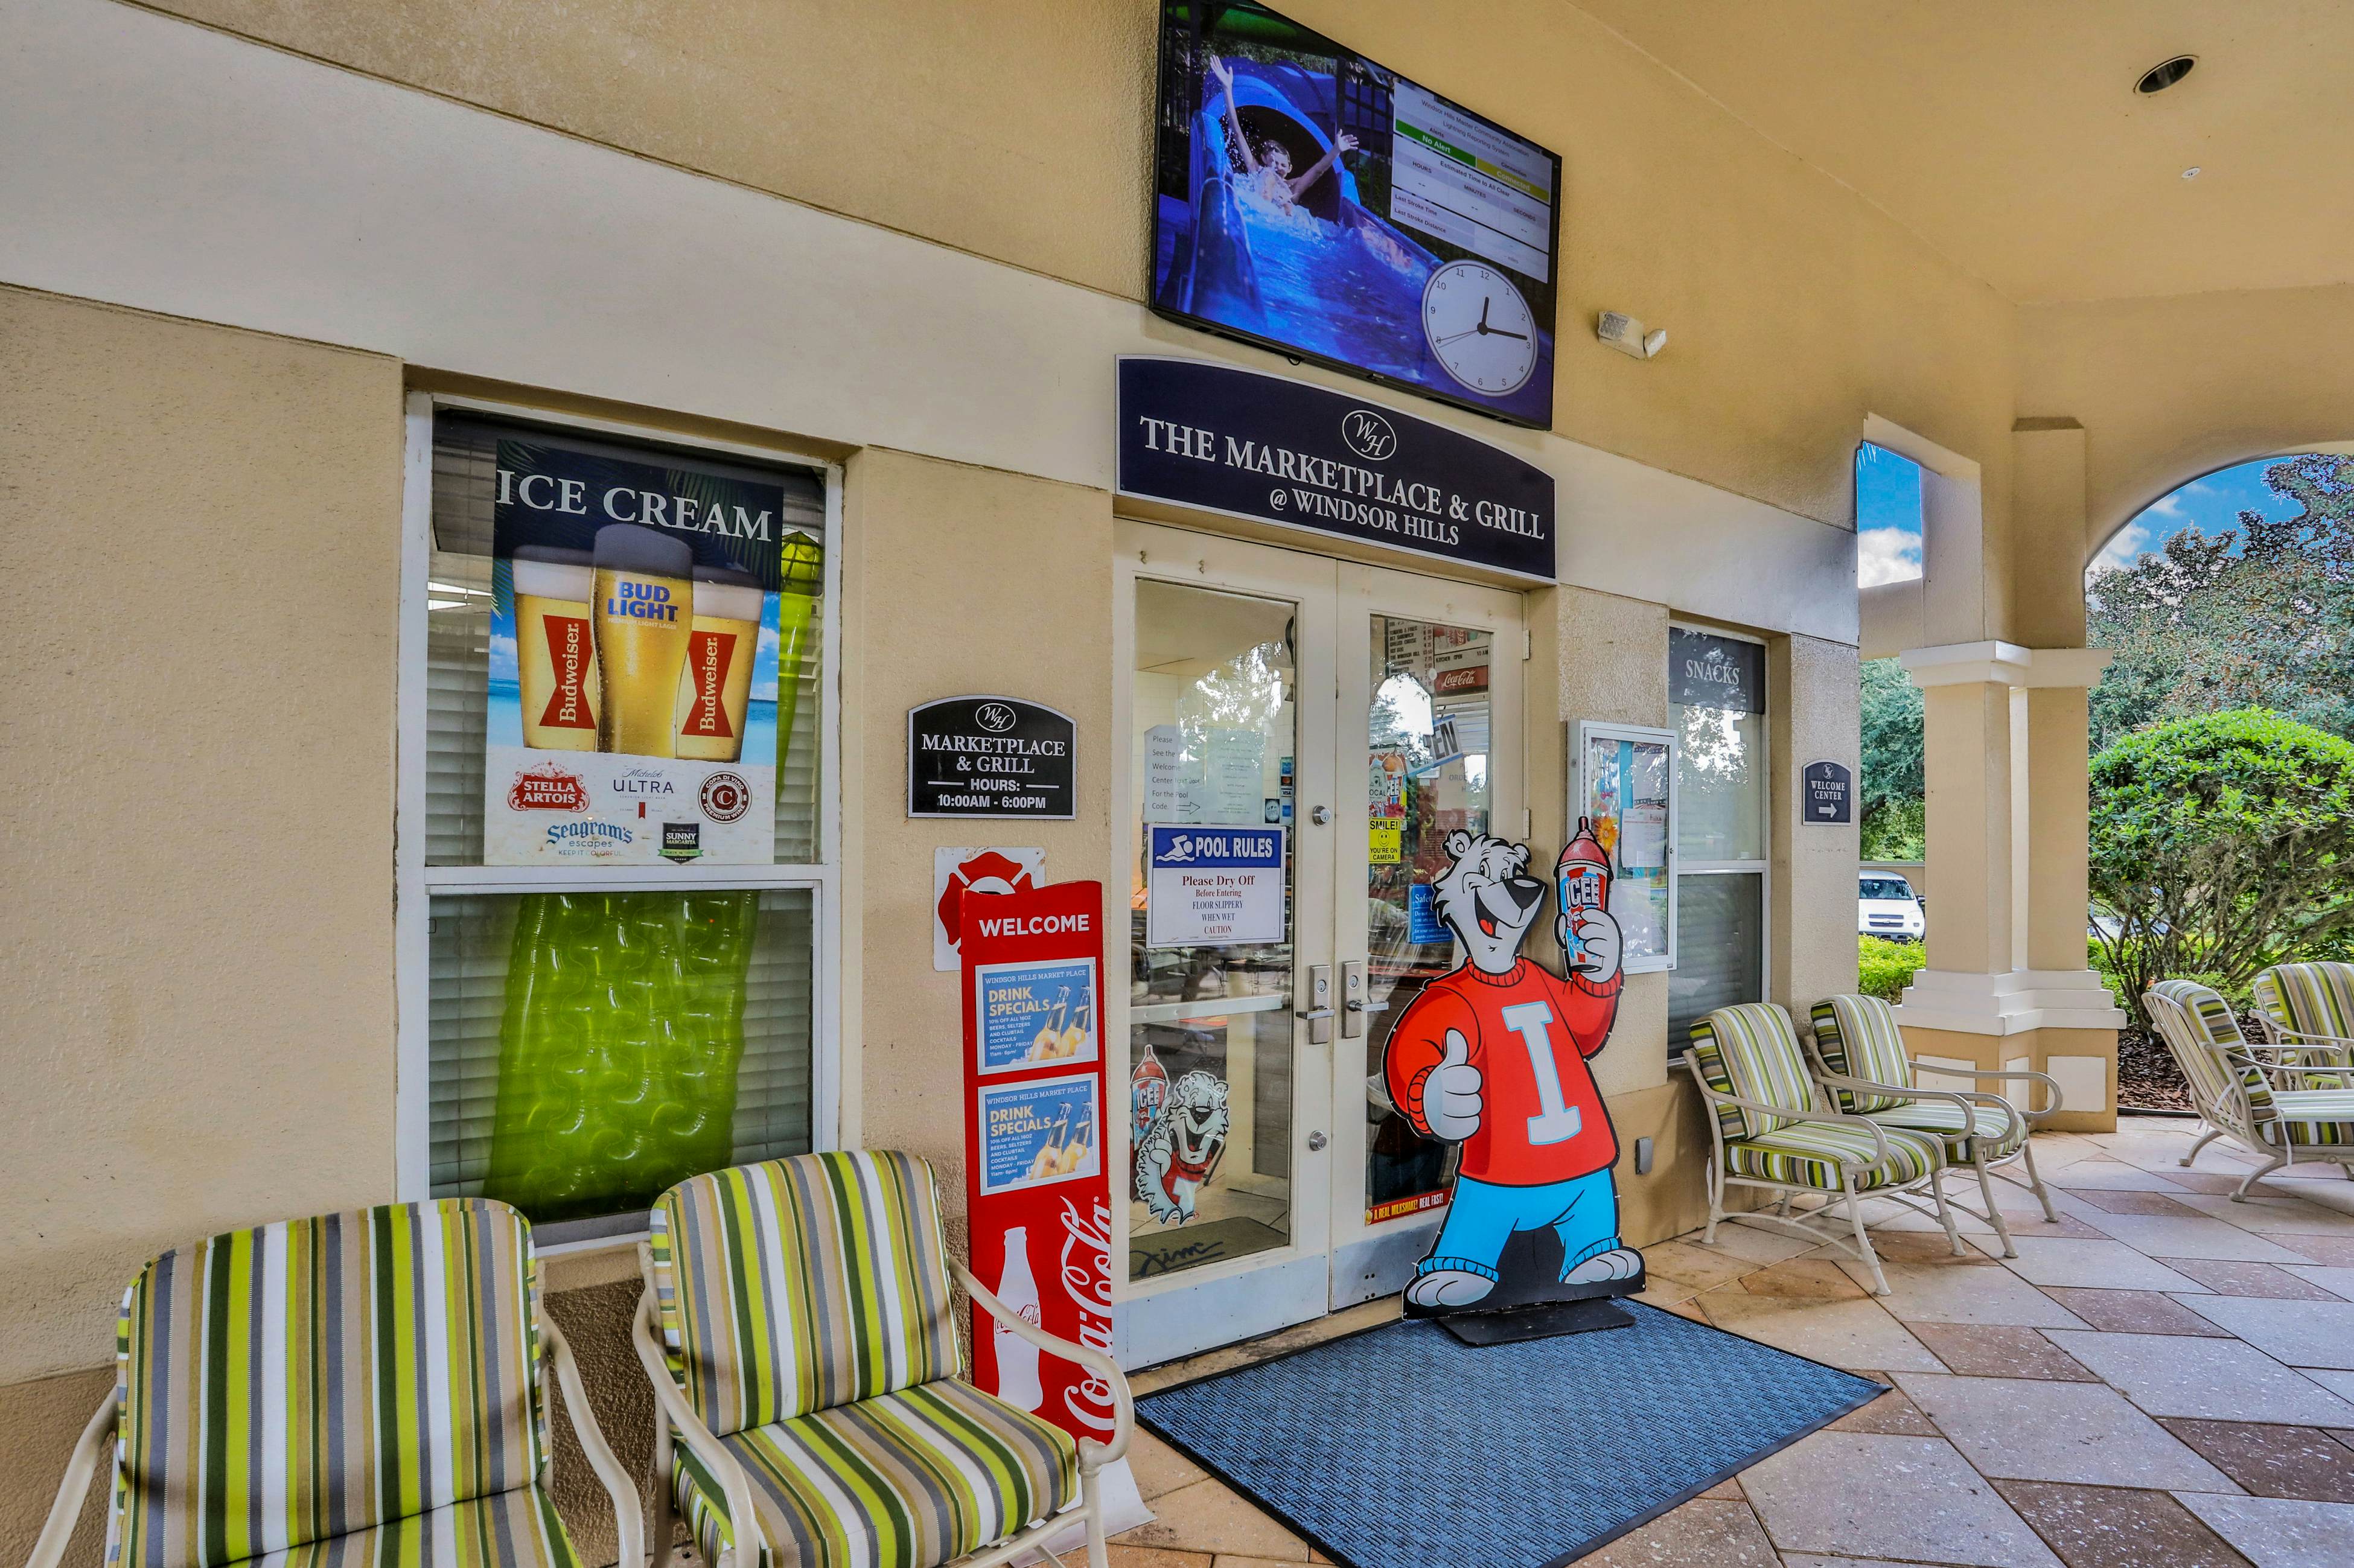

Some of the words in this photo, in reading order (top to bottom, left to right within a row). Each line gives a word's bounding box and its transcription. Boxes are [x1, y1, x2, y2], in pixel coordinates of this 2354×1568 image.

[1421, 99, 1443, 115] Windsor
[1444, 111, 1455, 120] Hills
[1456, 116, 1473, 130] Master
[1474, 124, 1502, 144] Community
[1502, 139, 1529, 157] Association
[1429, 127, 1444, 138] Alerts
[1422, 135, 1432, 145] No
[1434, 139, 1451, 153] Alert
[1443, 121, 1466, 137] Lightning
[1467, 132, 1491, 149] Reporting
[1491, 144, 1510, 157] System
[1412, 161, 1432, 174] HOURS
[1501, 162, 1527, 177] Connection
[1440, 160, 1467, 178] Estimated
[1468, 173, 1481, 183] Time
[1497, 186, 1510, 197] Clear
[1496, 171, 1530, 192] Connected
[1464, 184, 1487, 199] MINUTES
[1395, 194, 1406, 203] Last
[1408, 199, 1424, 210] Stroke
[1425, 206, 1438, 216] Time
[1394, 208, 1406, 218] Last
[1407, 212, 1423, 224] Stroke
[1424, 220, 1447, 234] Distance
[1513, 207, 1536, 221] SECONDS
[1456, 267, 1465, 278] 11
[1480, 270, 1490, 280] 12
[1436, 280, 1446, 290] 10
[1430, 306, 1436, 314] 9
[1478, 377, 1483, 386] 6
[1501, 378, 1507, 386] 5
[1139, 415, 1216, 463] THE
[1224, 435, 1442, 515] MARKETPLACE
[1449, 494, 1469, 521] &
[1475, 500, 1546, 541] GRILL
[496, 469, 587, 515] ICE
[603, 487, 773, 542] CREAM
[1269, 488, 1288, 511] @
[1292, 488, 1399, 534] WINDSOR
[1403, 517, 1459, 546] HILLS
[618, 581, 670, 603] BUD
[607, 598, 678, 622] LIGHT
[559, 622, 579, 723] Budweiser
[1443, 670, 1477, 687] Coca-Cola
[1685, 659, 1741, 686] SNACKS
[699, 637, 718, 731] Budweiser
[921, 733, 1066, 756] MARKETPLACE
[1153, 735, 1173, 744] Please
[1166, 749, 1175, 757] the
[956, 756, 971, 772] &
[977, 756, 1035, 774] GRILL
[622, 768, 665, 779] Michelob
[524, 780, 576, 792] STELLA
[613, 779, 674, 794] ULTRA
[706, 776, 722, 788] COPA
[731, 776, 745, 790] VINO
[970, 778, 1021, 792] HOURS:
[1811, 780, 1845, 791] WELCOME
[523, 792, 576, 804] ARTOIS
[937, 794, 990, 808] 10:00AM
[1001, 795, 1047, 809] 6:00PM
[1814, 791, 1842, 800] CENTER
[703, 803, 731, 820] PREMIUM
[730, 805, 745, 818] WINE
[546, 821, 633, 844] Seagram's
[1370, 820, 1398, 830] SMILE!
[569, 840, 613, 849] escapes
[1196, 837, 1230, 858] POOL
[1233, 837, 1273, 858] RULES
[1182, 875, 1213, 886] Please
[1216, 875, 1235, 888] Dry
[1239, 875, 1255, 885] Off
[1216, 888, 1242, 899] Entering
[1414, 893, 1433, 904] Safet
[1565, 877, 1600, 910] ICEE
[1192, 900, 1214, 910] FLOOR
[1214, 900, 1243, 909] SLIPPERY
[978, 913, 1090, 937] WELCOME
[1202, 913, 1220, 922] WHEN
[1222, 913, 1235, 922] WET
[1204, 925, 1232, 934] CAUTION
[985, 976, 1016, 984] WINDSOR
[1038, 972, 1065, 980] MARKET
[988, 986, 1033, 1003] DRINK
[989, 999, 1050, 1017] SPECIALS
[986, 1095, 1018, 1105] WINDSOR
[1019, 1092, 1038, 1101] HILLS
[1039, 1088, 1066, 1098] MARKET
[1067, 1085, 1088, 1094] PLACE
[1136, 1086, 1160, 1109] ICEE
[990, 1104, 1034, 1123] DRINK
[990, 1117, 1051, 1137] SPECIALS
[990, 1155, 1018, 1164] COCKTAILS
[990, 1162, 1013, 1171] MONDAY
[1374, 1209, 1379, 1220] A
[1379, 1206, 1390, 1219] REAL
[1391, 1199, 1418, 1216] MILKSHAKE!
[1419, 1196, 1431, 1209] REAL
[1431, 1193, 1443, 1206] FAST!
